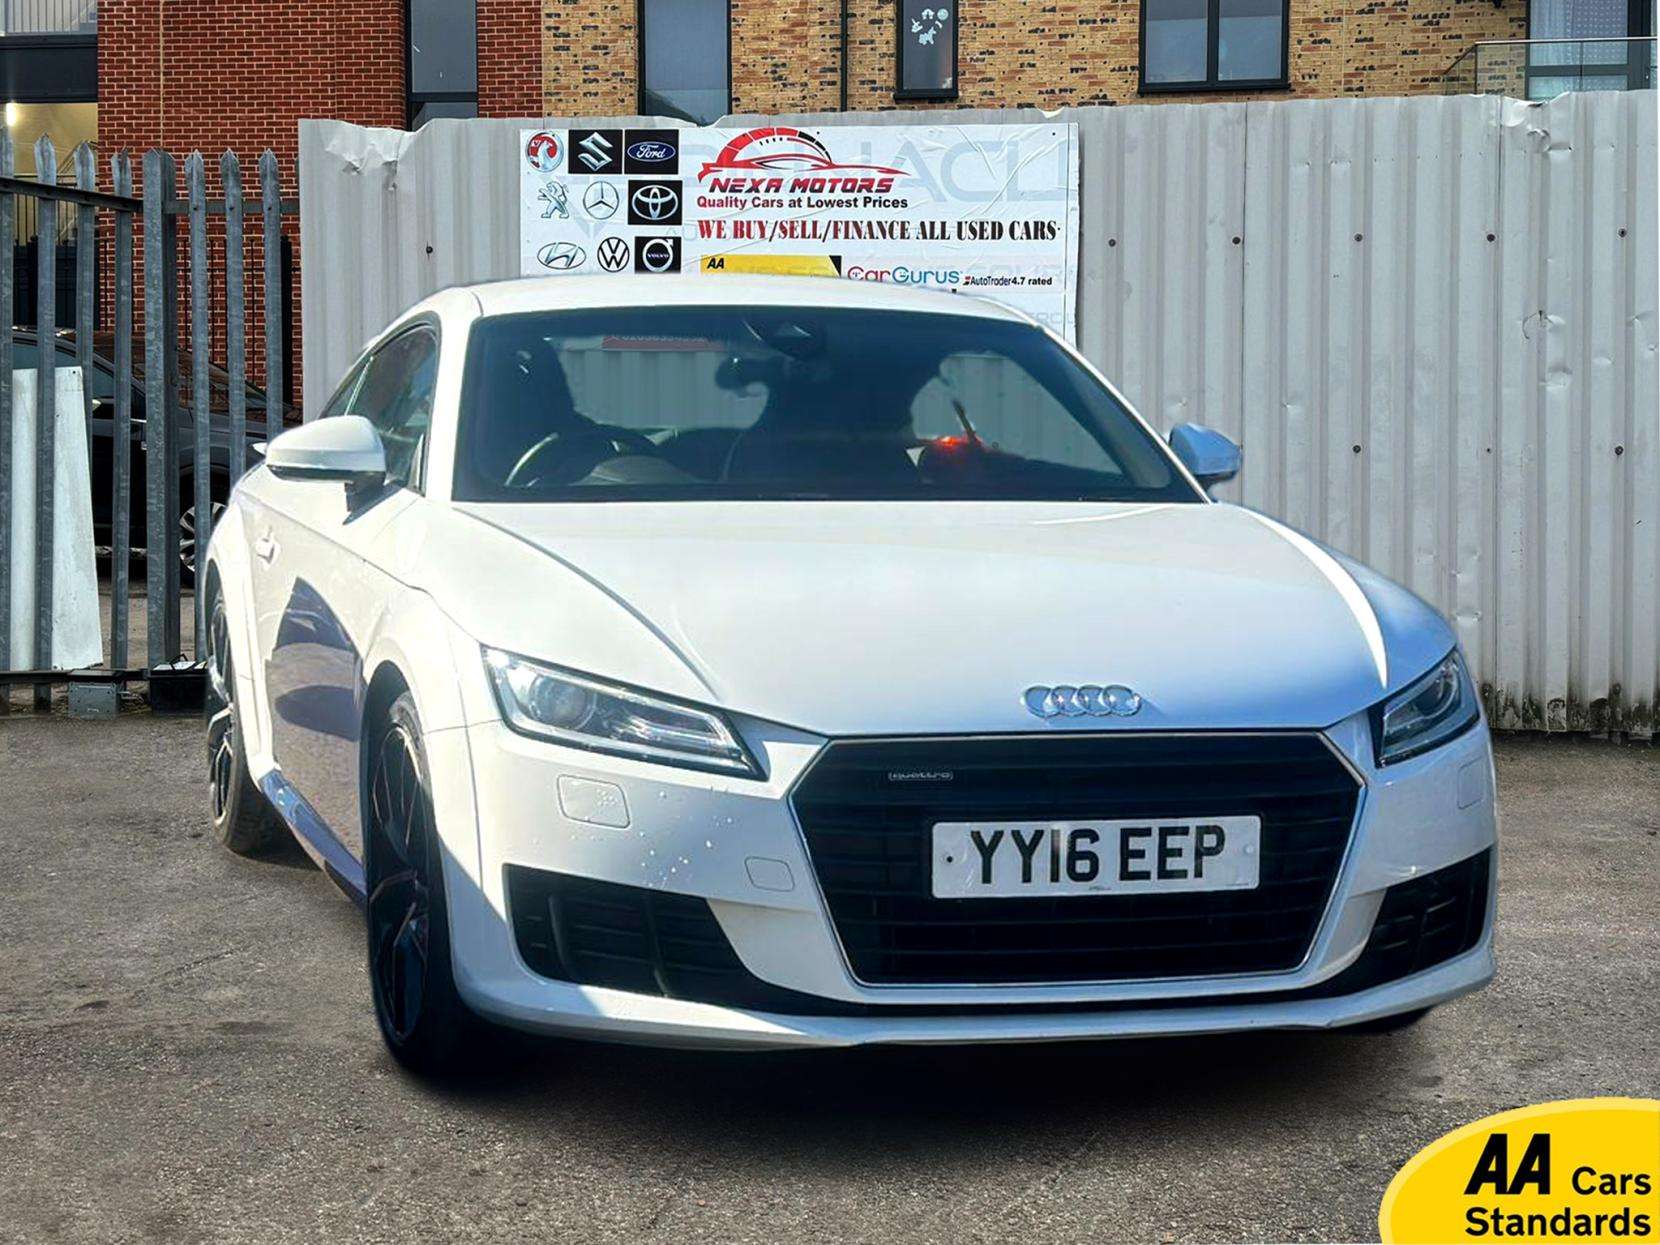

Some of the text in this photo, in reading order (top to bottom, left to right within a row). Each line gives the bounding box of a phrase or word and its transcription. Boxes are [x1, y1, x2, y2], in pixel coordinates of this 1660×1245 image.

[636, 144, 666, 158] Ford
[709, 178, 894, 193] NEXA MOTORS
[697, 196, 908, 210] Quality Cars at Lowest Prices
[697, 220, 727, 240] WE
[916, 221, 951, 240] ALL
[957, 221, 1003, 240] USED
[1008, 220, 1057, 240] CARS
[707, 257, 725, 269] AA
[847, 266, 960, 284] CarGurus
[1028, 276, 1053, 286] rated
[970, 825, 1226, 884] YY16 EEP
